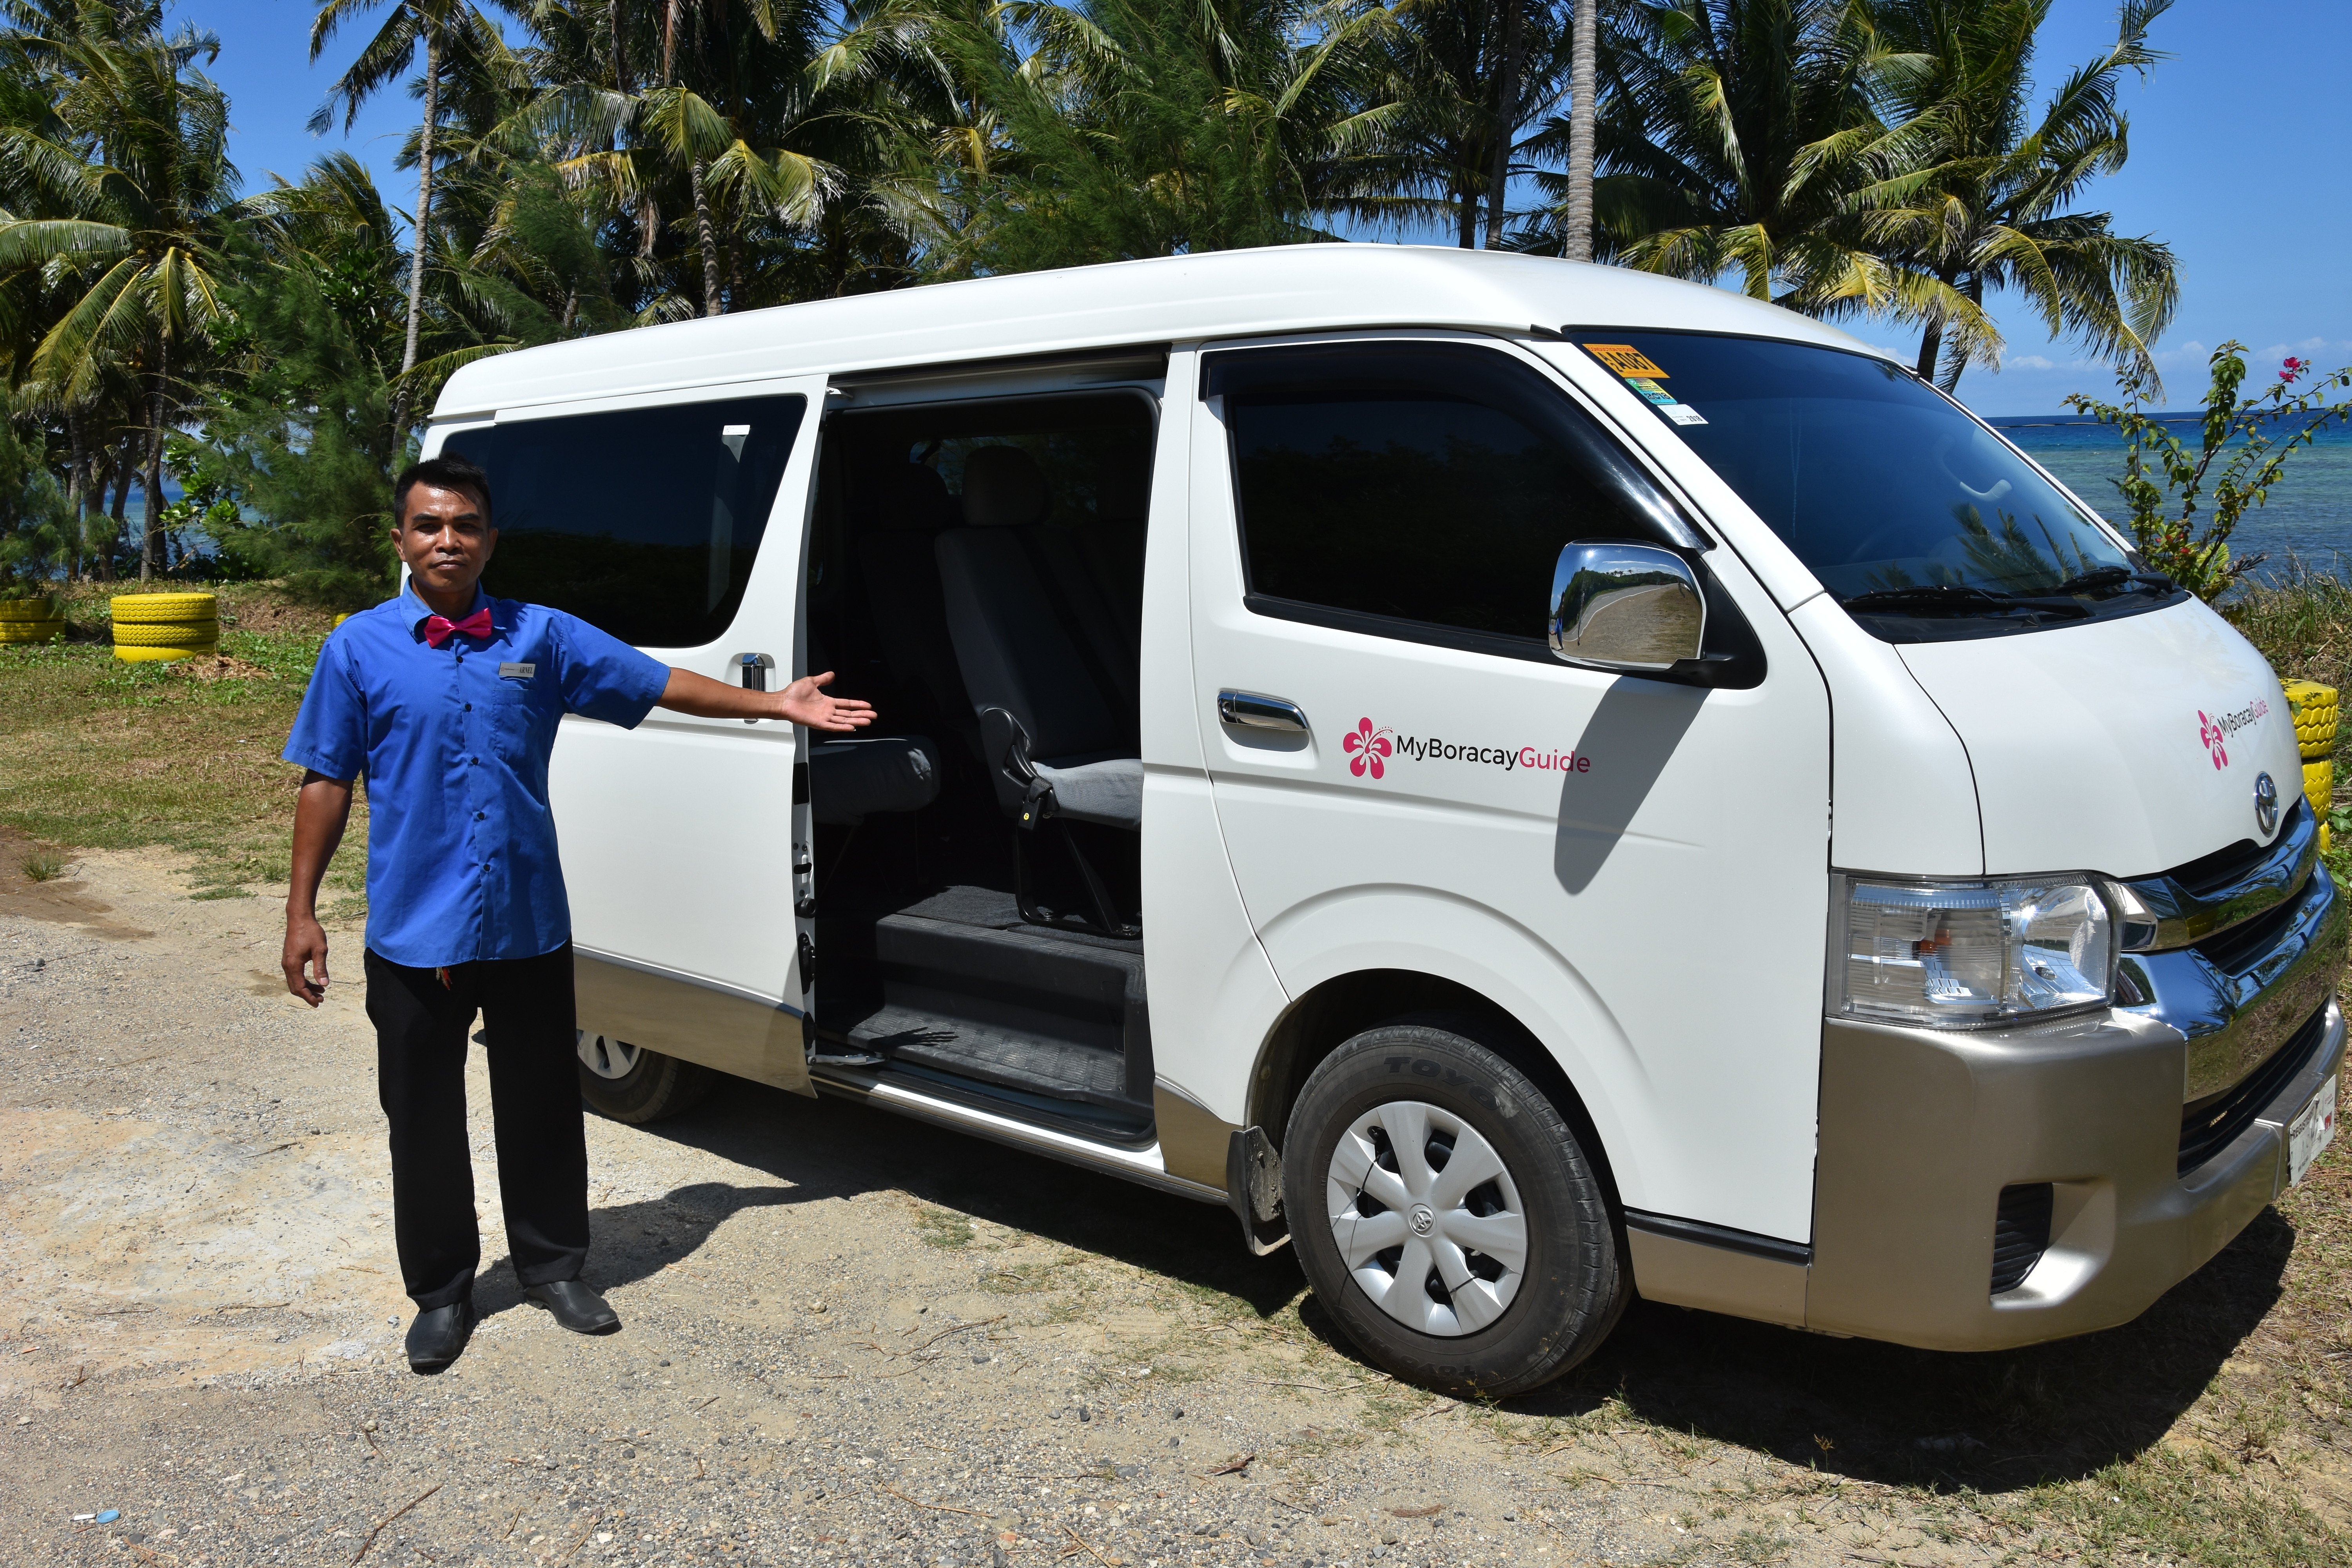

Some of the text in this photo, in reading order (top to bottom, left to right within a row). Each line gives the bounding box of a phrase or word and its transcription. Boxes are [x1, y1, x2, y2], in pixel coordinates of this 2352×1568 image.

[2217, 696, 2268, 738] MyBoracayGuide
[1397, 735, 1591, 773] MyBoracayGuide
[1384, 1056, 1500, 1111] TOYO
[1400, 1354, 1476, 1376] TOYO
